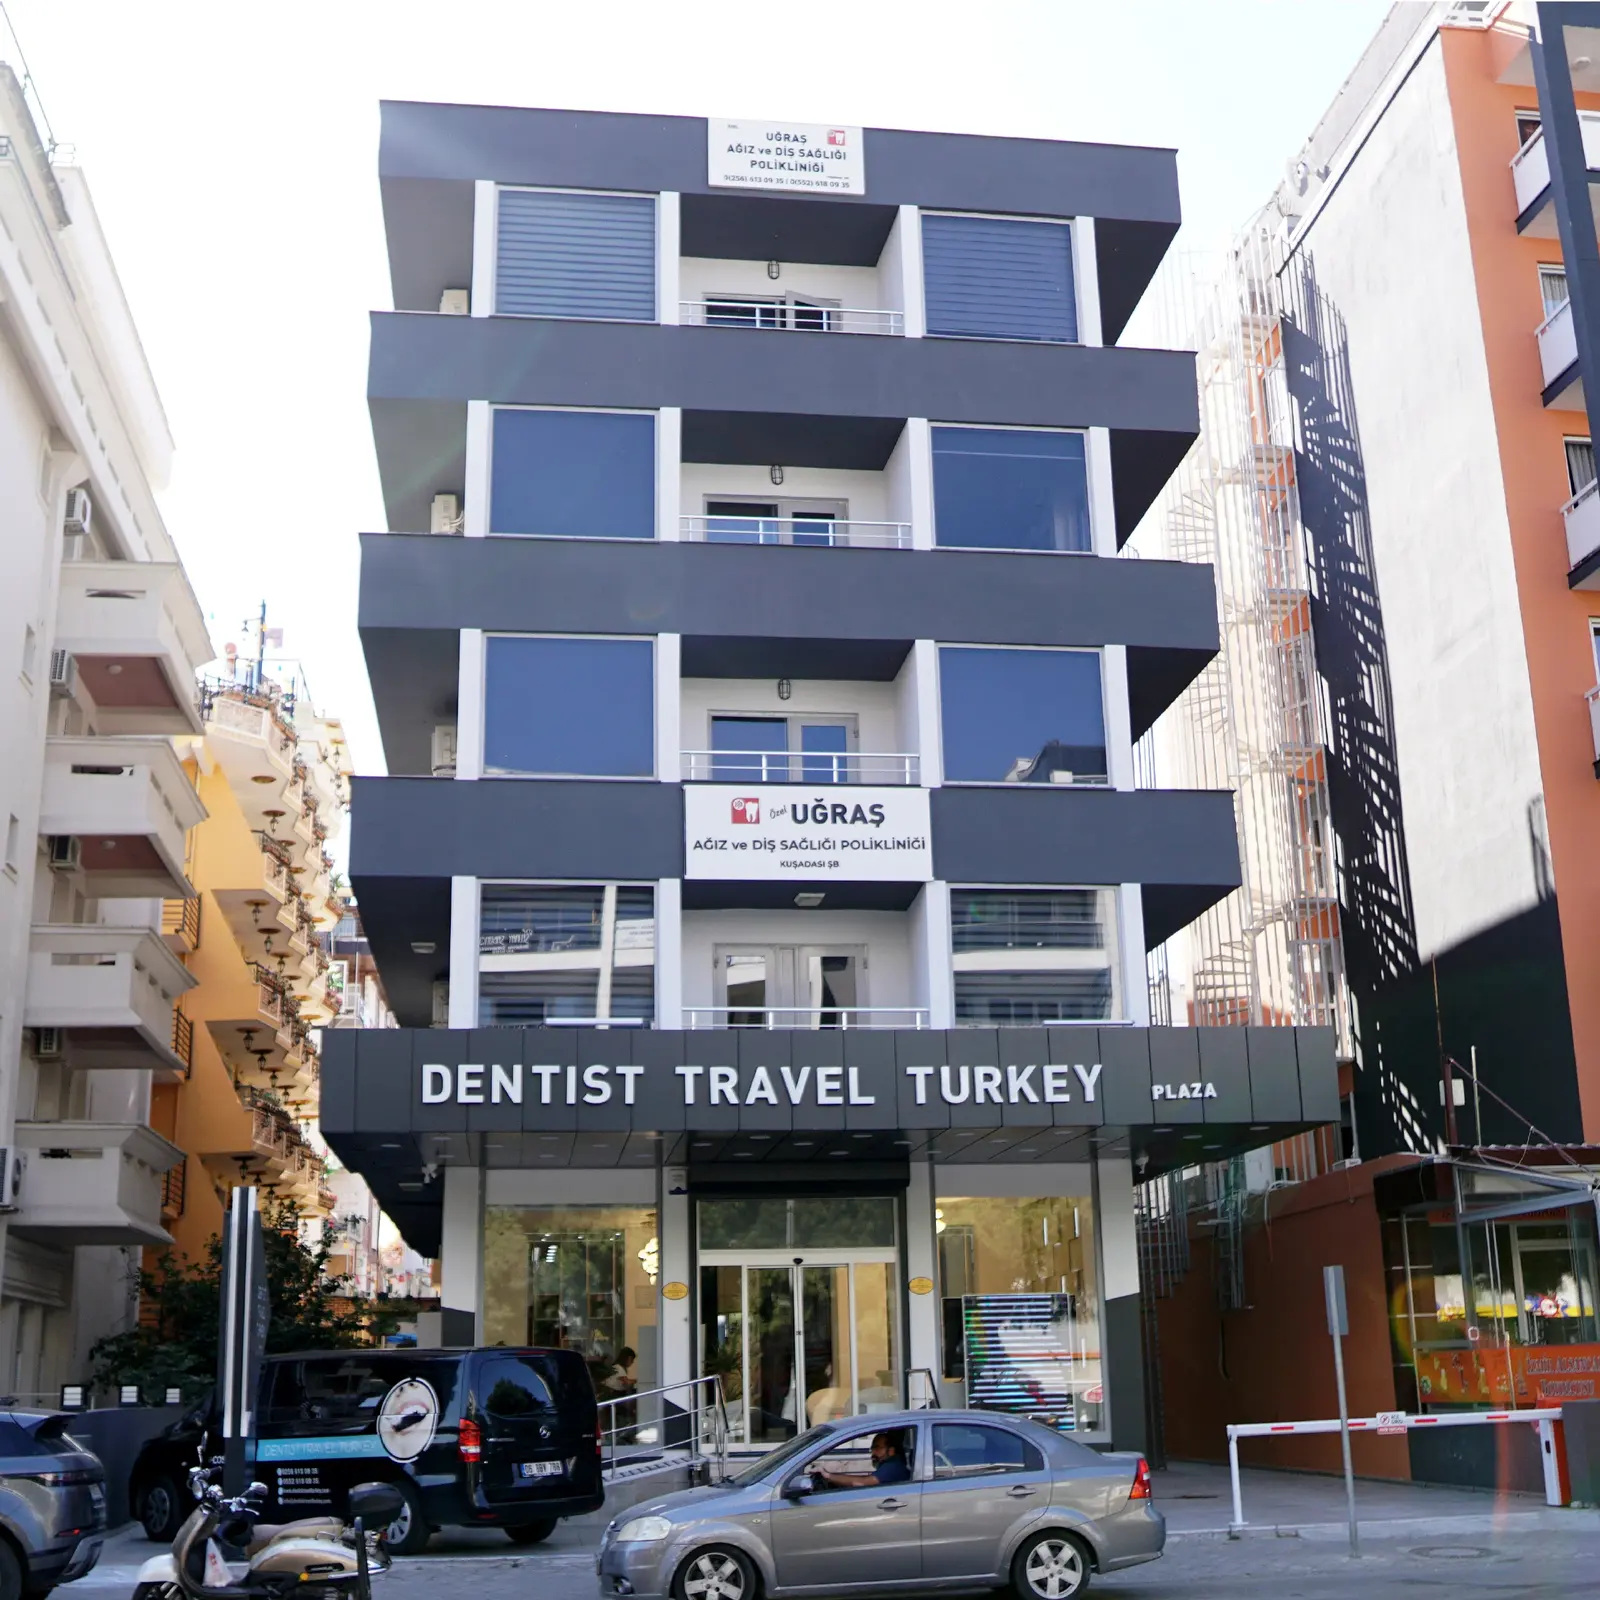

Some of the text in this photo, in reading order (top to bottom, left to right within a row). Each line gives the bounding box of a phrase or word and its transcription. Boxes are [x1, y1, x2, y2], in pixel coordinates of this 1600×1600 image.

[766, 131, 808, 146] UĞRAŞ
[727, 143, 847, 161] AĞIZ ve DİŞ SAĞLIĞI
[750, 159, 825, 173] POLİKLİNİĞİ
[791, 797, 886, 828] UĞRAŞ
[693, 836, 926, 853] AĞIZ ve DİŞ SAĞLIĞI POLİKLİNİĞİ
[779, 860, 840, 870] KUŞADASI ŞB
[422, 1064, 1218, 1105] DENTIST TRAVEL TURKEY PLAZA
